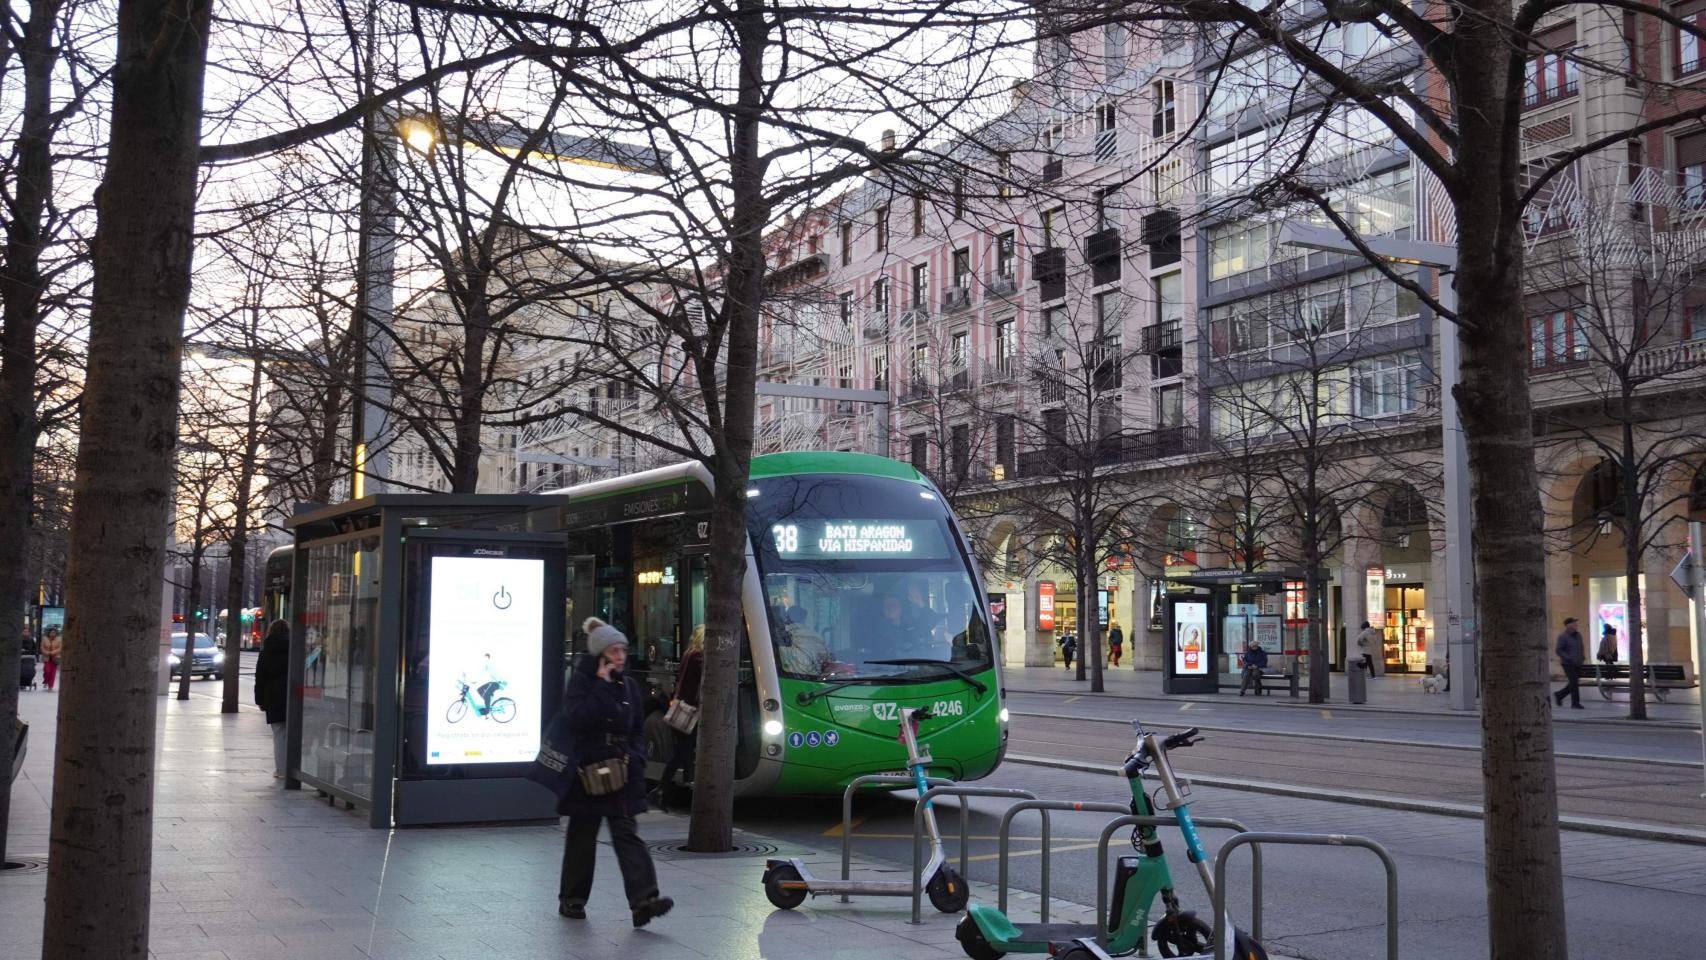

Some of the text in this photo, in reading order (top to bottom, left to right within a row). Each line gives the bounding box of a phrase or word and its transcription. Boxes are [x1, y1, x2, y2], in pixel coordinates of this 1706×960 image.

[773, 525, 798, 552] 38
[825, 526, 905, 538] BAJO ARAGON
[818, 539, 913, 552] VIA HISPANIDAD
[834, 704, 866, 713] avanza
[932, 700, 963, 717] 4246
